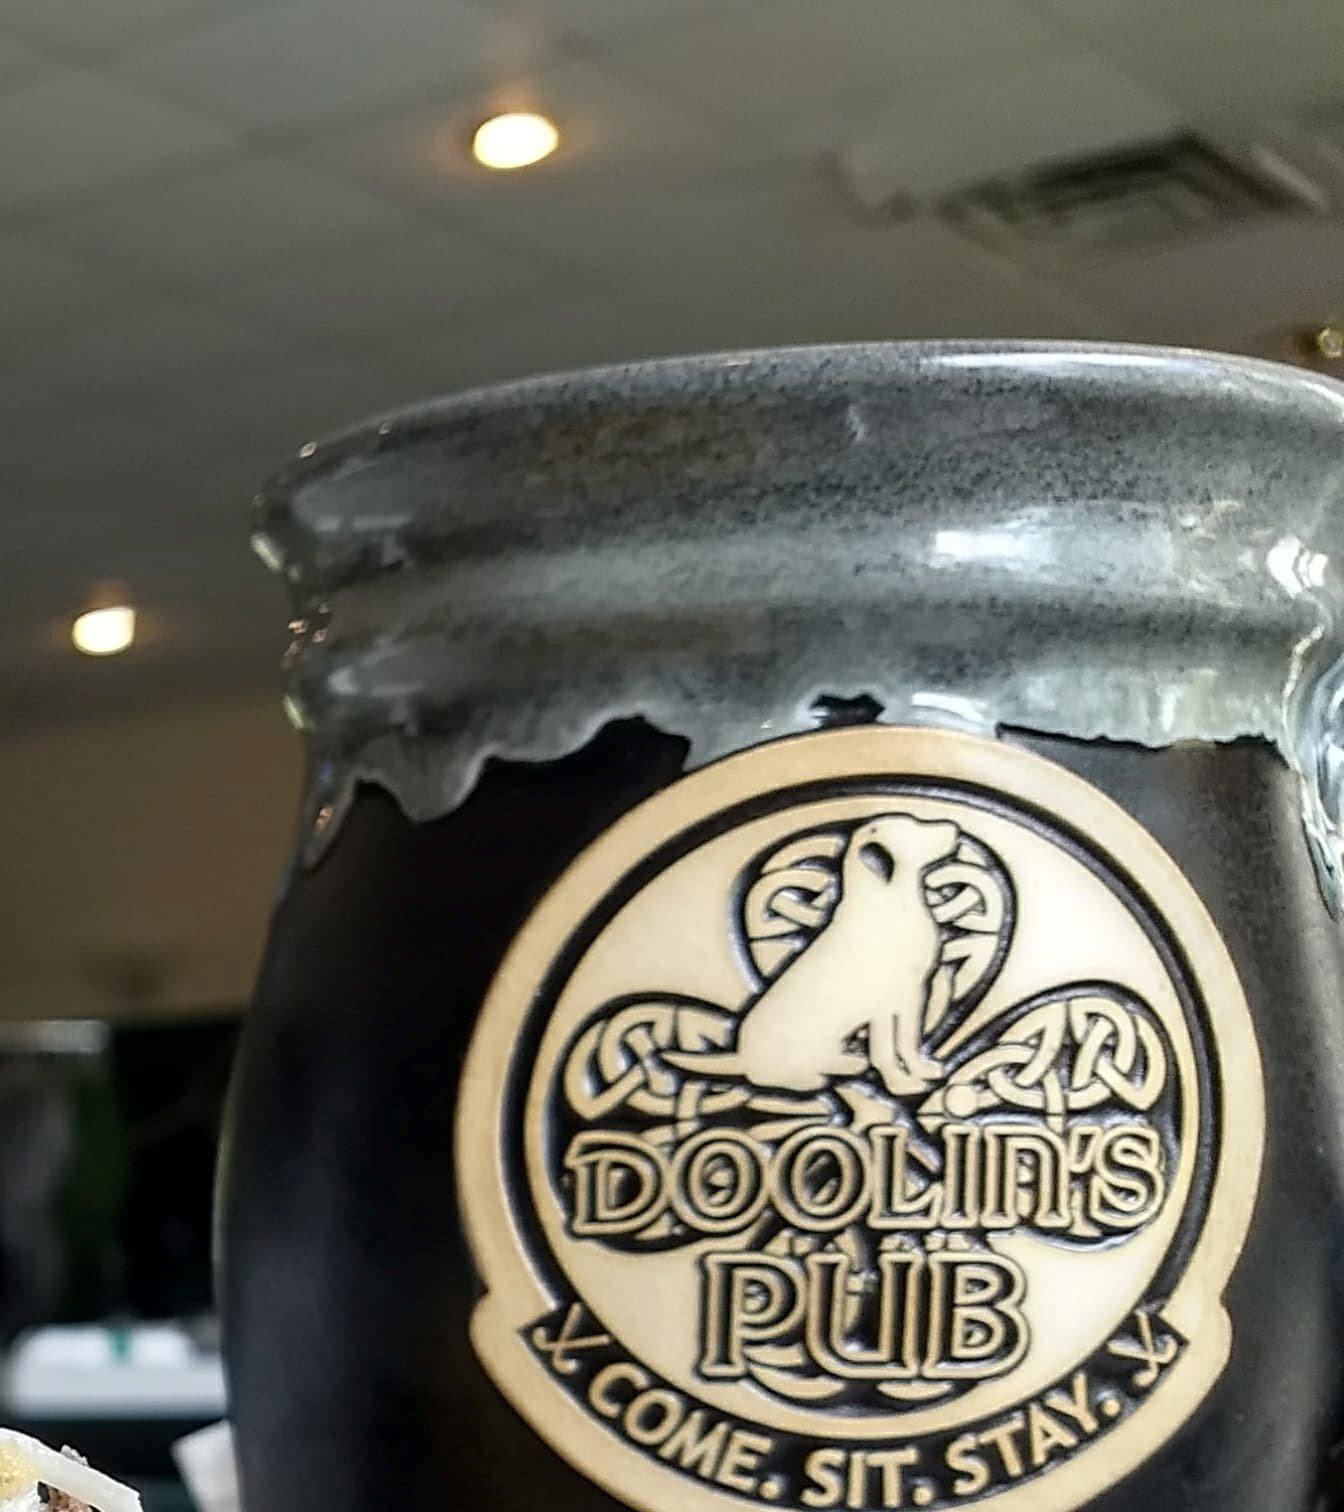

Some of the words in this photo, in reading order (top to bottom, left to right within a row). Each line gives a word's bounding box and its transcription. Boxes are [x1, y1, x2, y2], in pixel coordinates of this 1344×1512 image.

[564, 1125, 1167, 1236] DOOLIN'S
[699, 1250, 1029, 1380] PUB
[586, 1361, 780, 1499] COME.
[800, 1447, 934, 1510] SIT.
[946, 1372, 1122, 1495] STAY.
